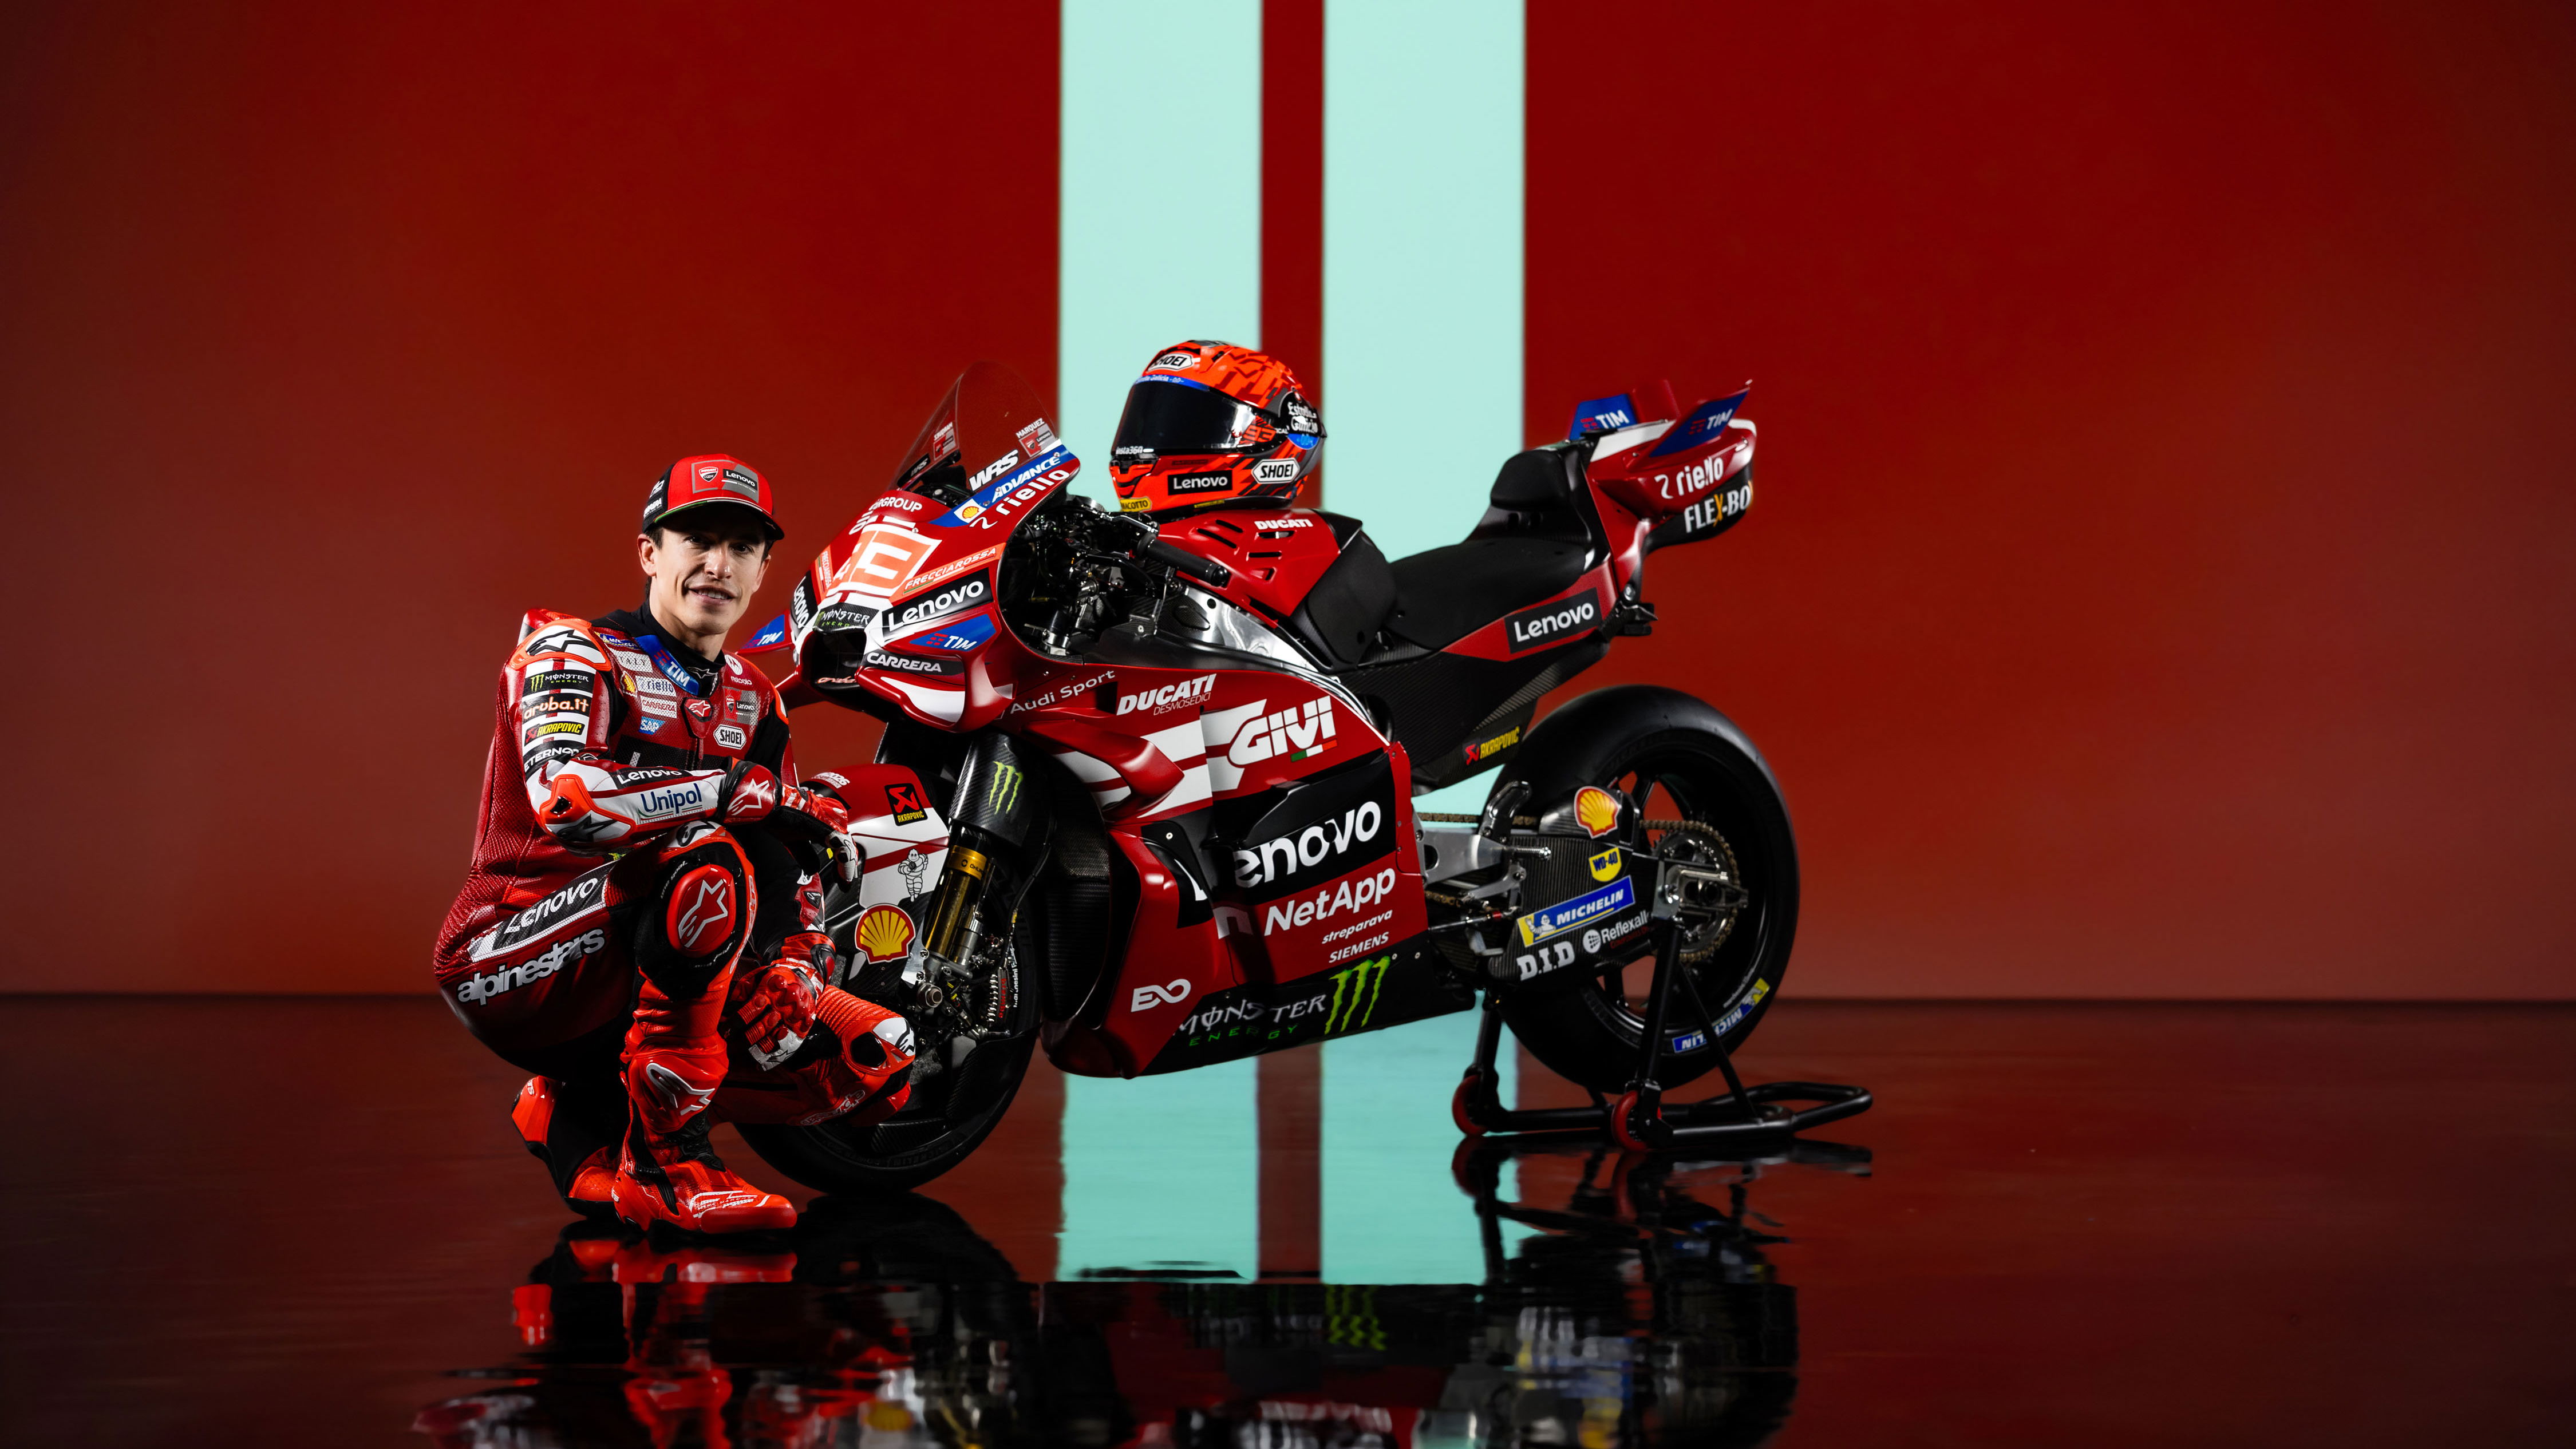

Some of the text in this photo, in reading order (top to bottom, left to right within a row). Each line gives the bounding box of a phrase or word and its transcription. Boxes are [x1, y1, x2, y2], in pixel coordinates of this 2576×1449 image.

[1153, 355, 1187, 367] HOEI
[1016, 418, 1045, 438] MARQUEZ
[1595, 410, 1629, 429] TIM
[1707, 409, 1733, 430] TIM
[726, 470, 756, 486] Lenovo
[969, 449, 1019, 492] WRS
[991, 456, 1061, 503] ADVANCE
[1173, 474, 1228, 490] Lenovo
[1261, 464, 1294, 478] SHOEI
[1676, 457, 1724, 496] riello
[995, 469, 1070, 516] riello
[1254, 518, 1313, 530] DUCATI
[904, 547, 997, 591] FRECCIAROSSA
[823, 608, 870, 624] MONSTER
[888, 580, 984, 632] Lenovo
[1514, 603, 1594, 643] Lenovo
[757, 631, 783, 646] TIM
[943, 635, 977, 650] TIM
[867, 652, 942, 672] CARRERA
[545, 672, 589, 682] MONSTER
[666, 661, 690, 687] TIM
[730, 676, 753, 686] motorola
[647, 680, 674, 693] riello
[1010, 670, 1116, 715] Audi Sport
[1116, 674, 1217, 716] DUCATI
[524, 696, 589, 720] aruba.it
[642, 699, 676, 712] CARRERA
[736, 702, 754, 711] Lenovo
[1153, 692, 1211, 716] DESMOSEDICI
[641, 718, 658, 733] SAP
[720, 729, 742, 745] SHOEI
[1228, 695, 1336, 766] GIVI
[617, 769, 682, 785] Lenovo
[640, 782, 703, 815] Unipol
[1592, 852, 1618, 872] WD-40
[504, 877, 598, 934] Lenovo
[1264, 868, 1396, 936] NetApp
[1556, 888, 1625, 926] MICHELIN
[1321, 909, 1393, 944] streparava
[1329, 932, 1390, 964] SIEMENS
[458, 928, 606, 1006] alpinestars
[1516, 940, 1575, 981] D.I.D
[1174, 993, 1327, 1037] MONSTER
[1189, 1024, 1298, 1047] ENERGY
